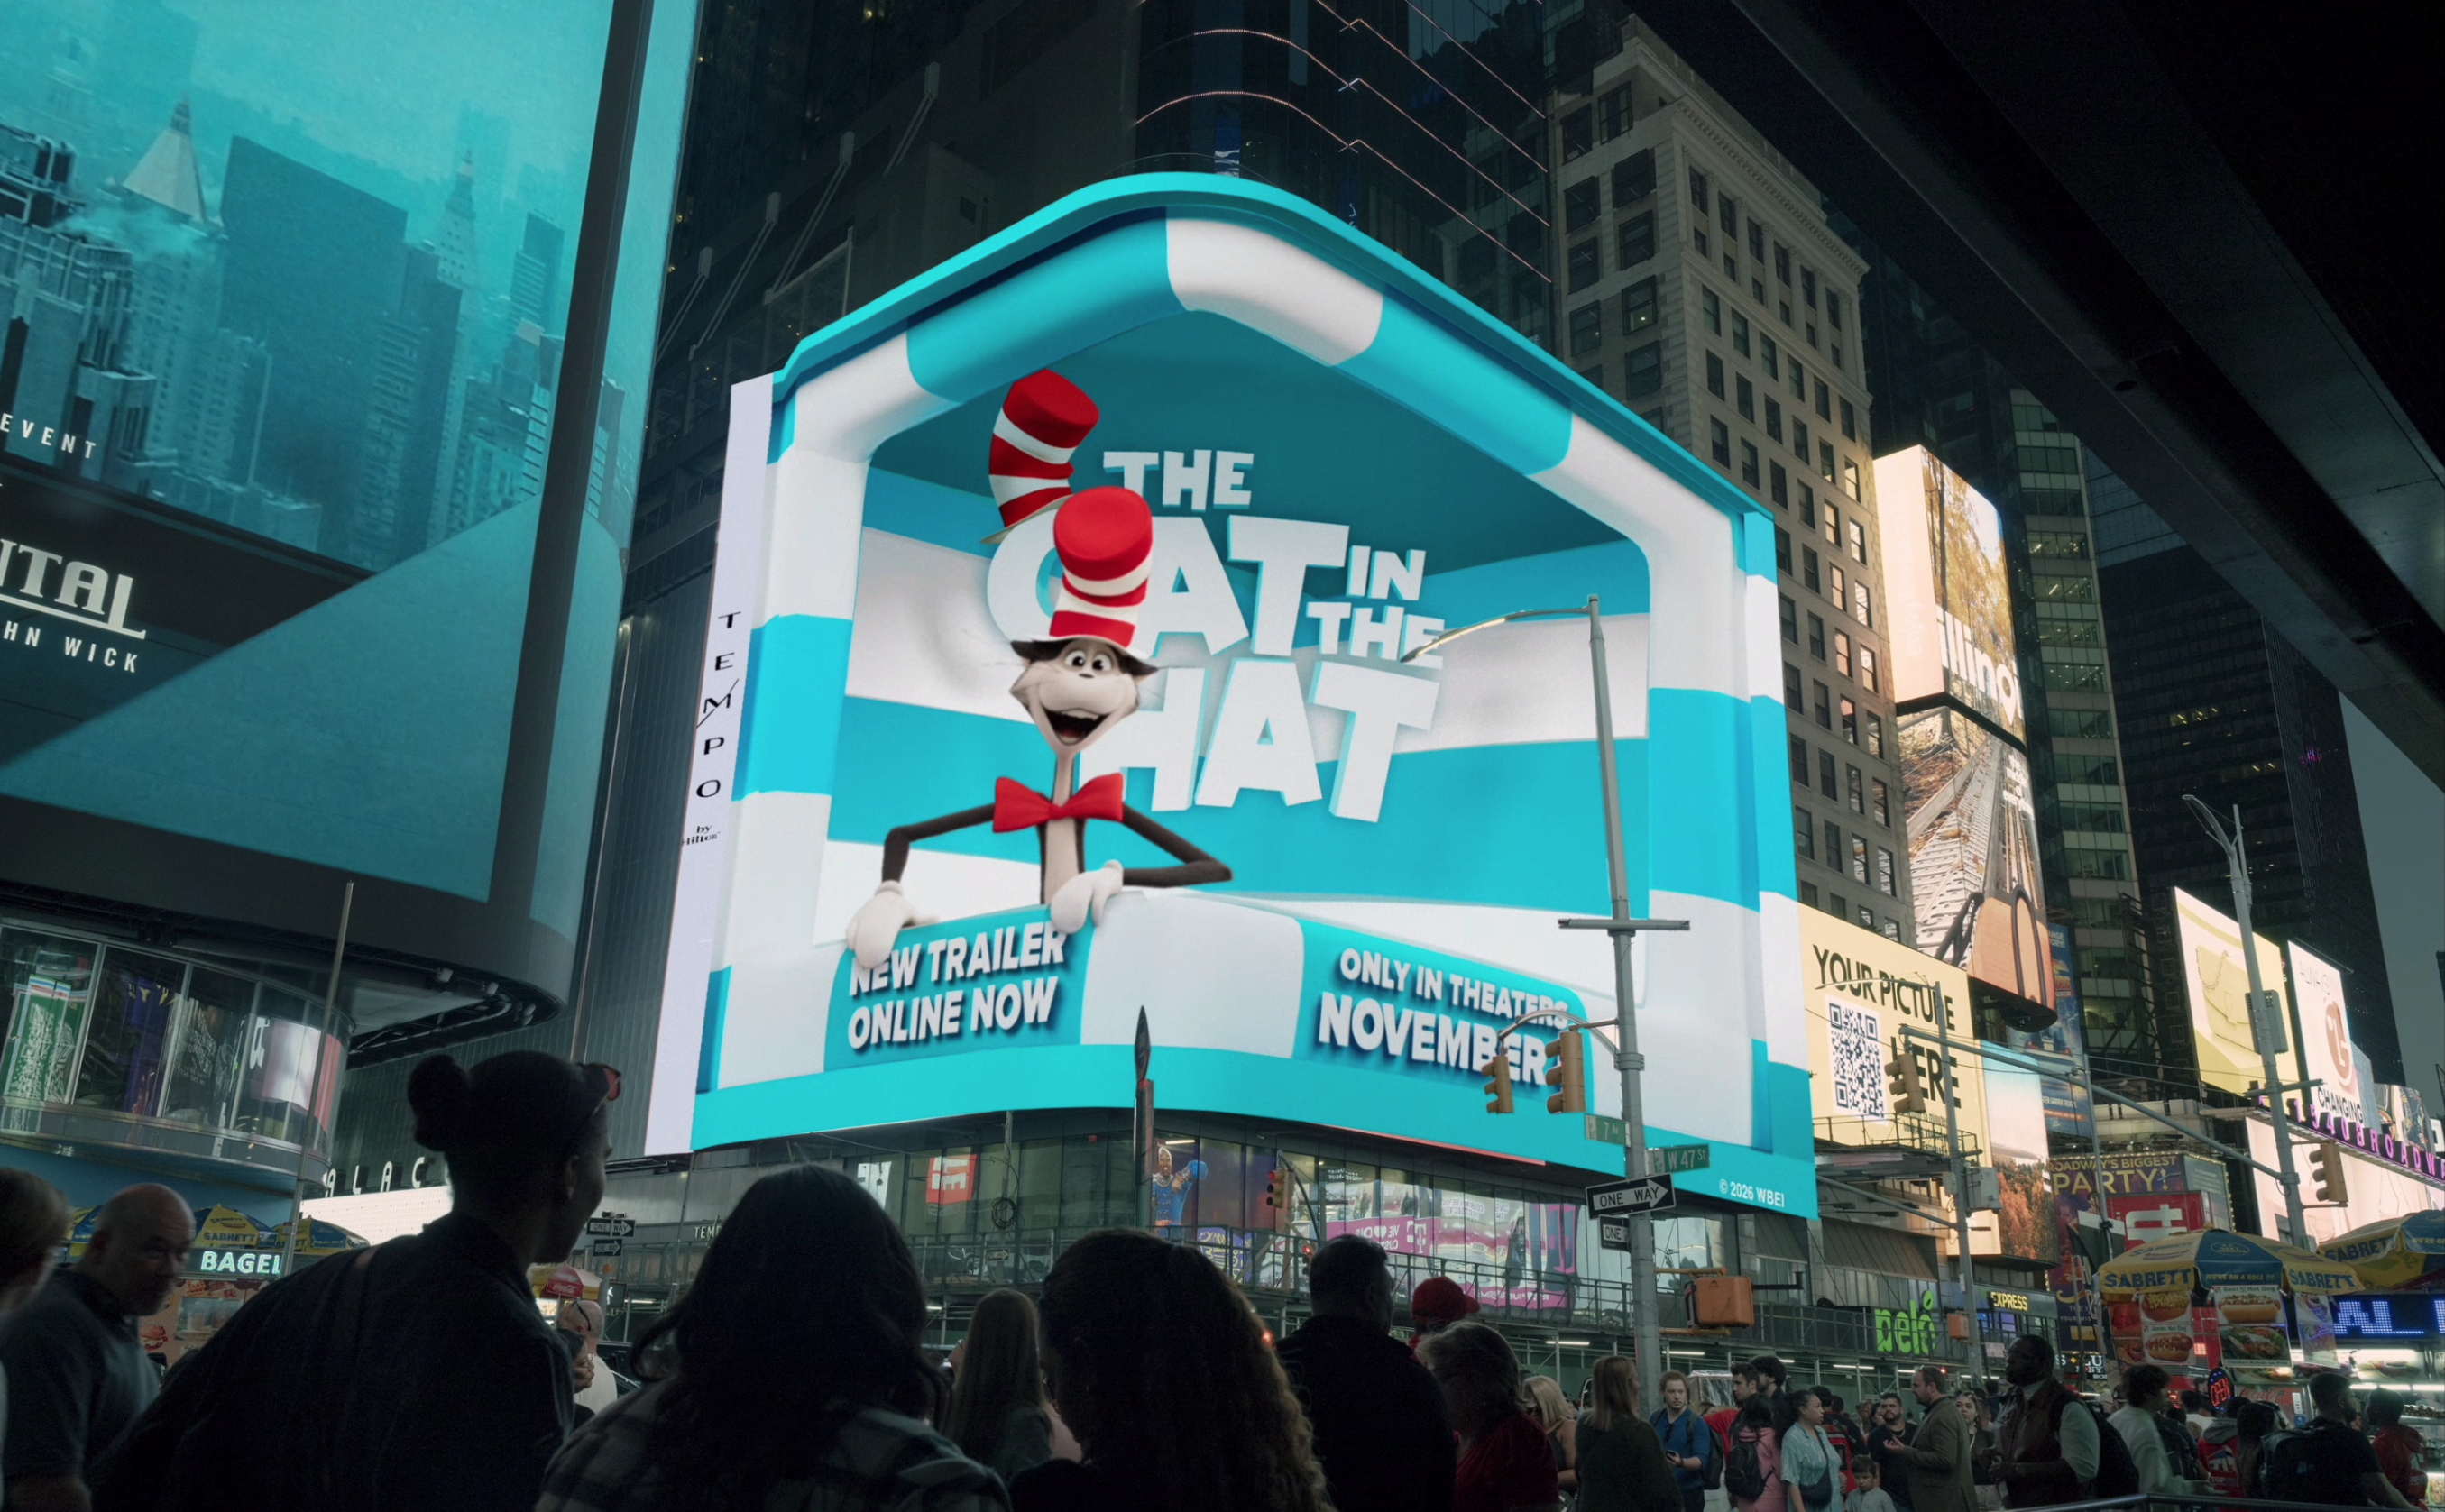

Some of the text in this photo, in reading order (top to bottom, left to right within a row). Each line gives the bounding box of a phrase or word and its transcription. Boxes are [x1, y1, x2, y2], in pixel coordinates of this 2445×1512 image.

[0, 413, 96, 459] EVENT
[1102, 449, 1255, 511] THE
[1347, 545, 1427, 601] IN
[4, 620, 138, 673] HN WICK
[1306, 601, 1445, 670] THE
[696, 611, 741, 798] TEMPO
[1079, 658, 1440, 823] HAT
[682, 833, 718, 846] Hilton
[696, 825, 712, 835] by
[850, 920, 1068, 996] NEW TRAILER
[1812, 944, 1877, 1003] YOUR
[1340, 948, 1570, 1031] ONLY IN THEATERS
[848, 976, 1060, 1049] ONLINE NOW
[1319, 991, 1548, 1086] NOVEMBER
[2318, 1086, 2364, 1123] CHANGING
[1604, 1122, 1619, 1141] 7 Av
[1668, 1149, 1706, 1170] W 47 St
[2047, 1155, 2177, 1172] ROADWAY'S BIGGEST
[323, 1157, 450, 1197] ALAC
[1599, 1186, 1659, 1208] ONE WAY
[1730, 1181, 1754, 1201] 2026
[1756, 1187, 1785, 1208] WBEI
[204, 1232, 257, 1242] SABRETT
[593, 1223, 629, 1233] ONE WAY
[1604, 1226, 1622, 1241] ONE
[2103, 1269, 2192, 1288] SABRETT
[2205, 1273, 2228, 1281] WE'RE
[2229, 1273, 2238, 1281] ON
[2247, 1273, 2264, 1281] ROLL
[2288, 1269, 2357, 1289] SABRETT
[1990, 1291, 2028, 1311] EXPRESS
